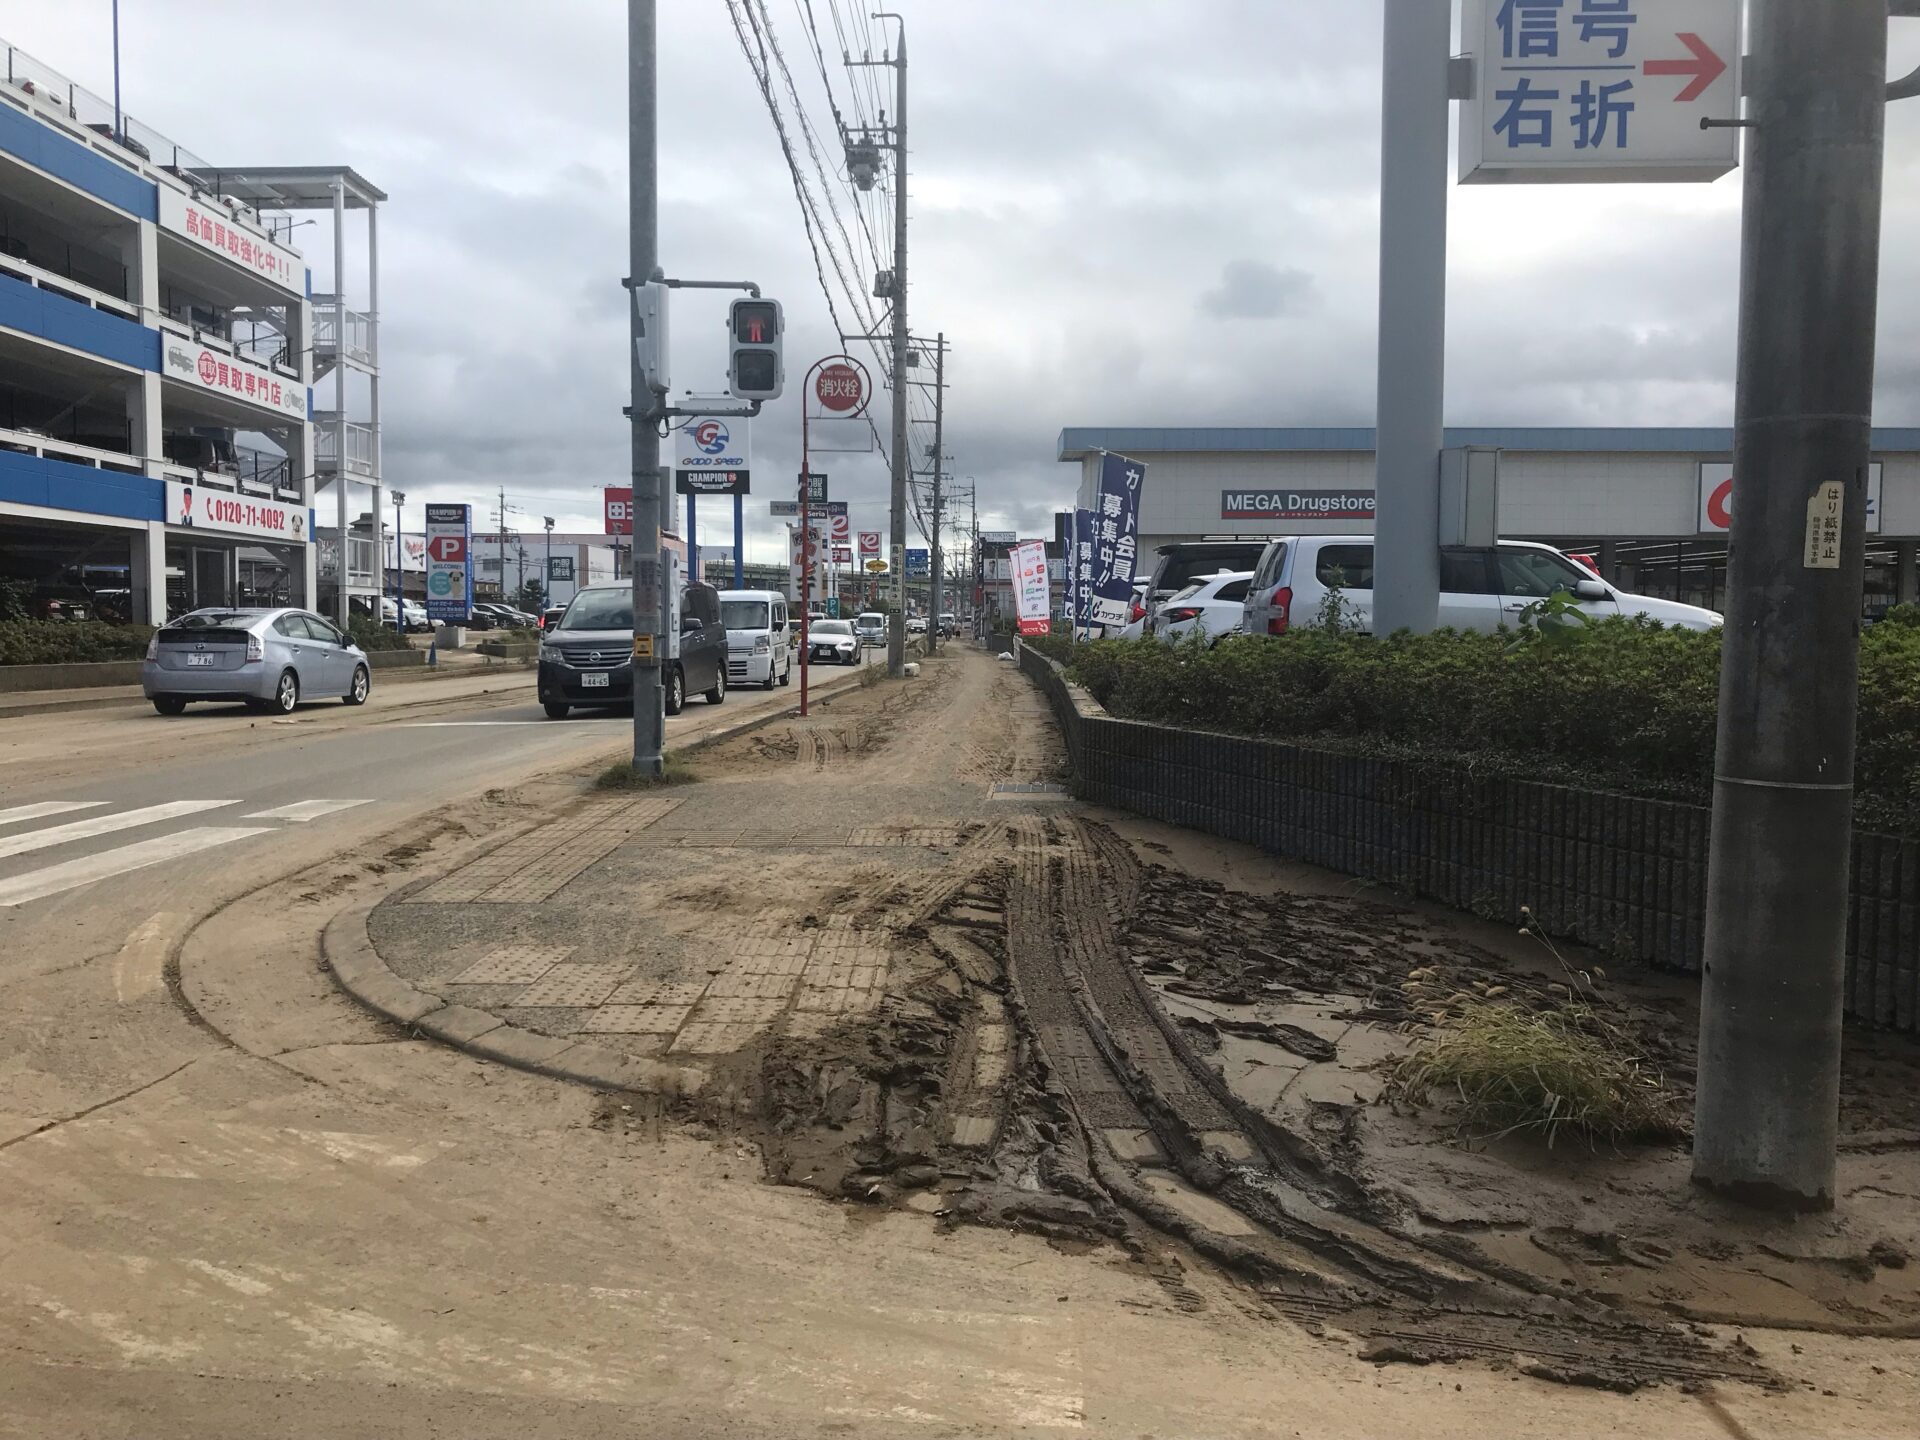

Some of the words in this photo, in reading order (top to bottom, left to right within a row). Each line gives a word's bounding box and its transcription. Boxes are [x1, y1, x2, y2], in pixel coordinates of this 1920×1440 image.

[1496, 0, 1637, 58] 信号
[1492, 77, 1635, 148] 右折
[218, 362, 281, 405] 買取専門店
[821, 379, 858, 398] 消火栓
[682, 458, 712, 466] GOOD
[713, 458, 743, 466] SPEED
[688, 472, 728, 483] CHAMPION
[1227, 494, 1282, 510] MEGA
[1288, 494, 1375, 511] Drugstore
[216, 500, 285, 530] 0120-71-4092
[1822, 488, 1839, 559] はり紙禁止
[441, 539, 460, 560] P
[1101, 609, 1124, 621] カワチ
